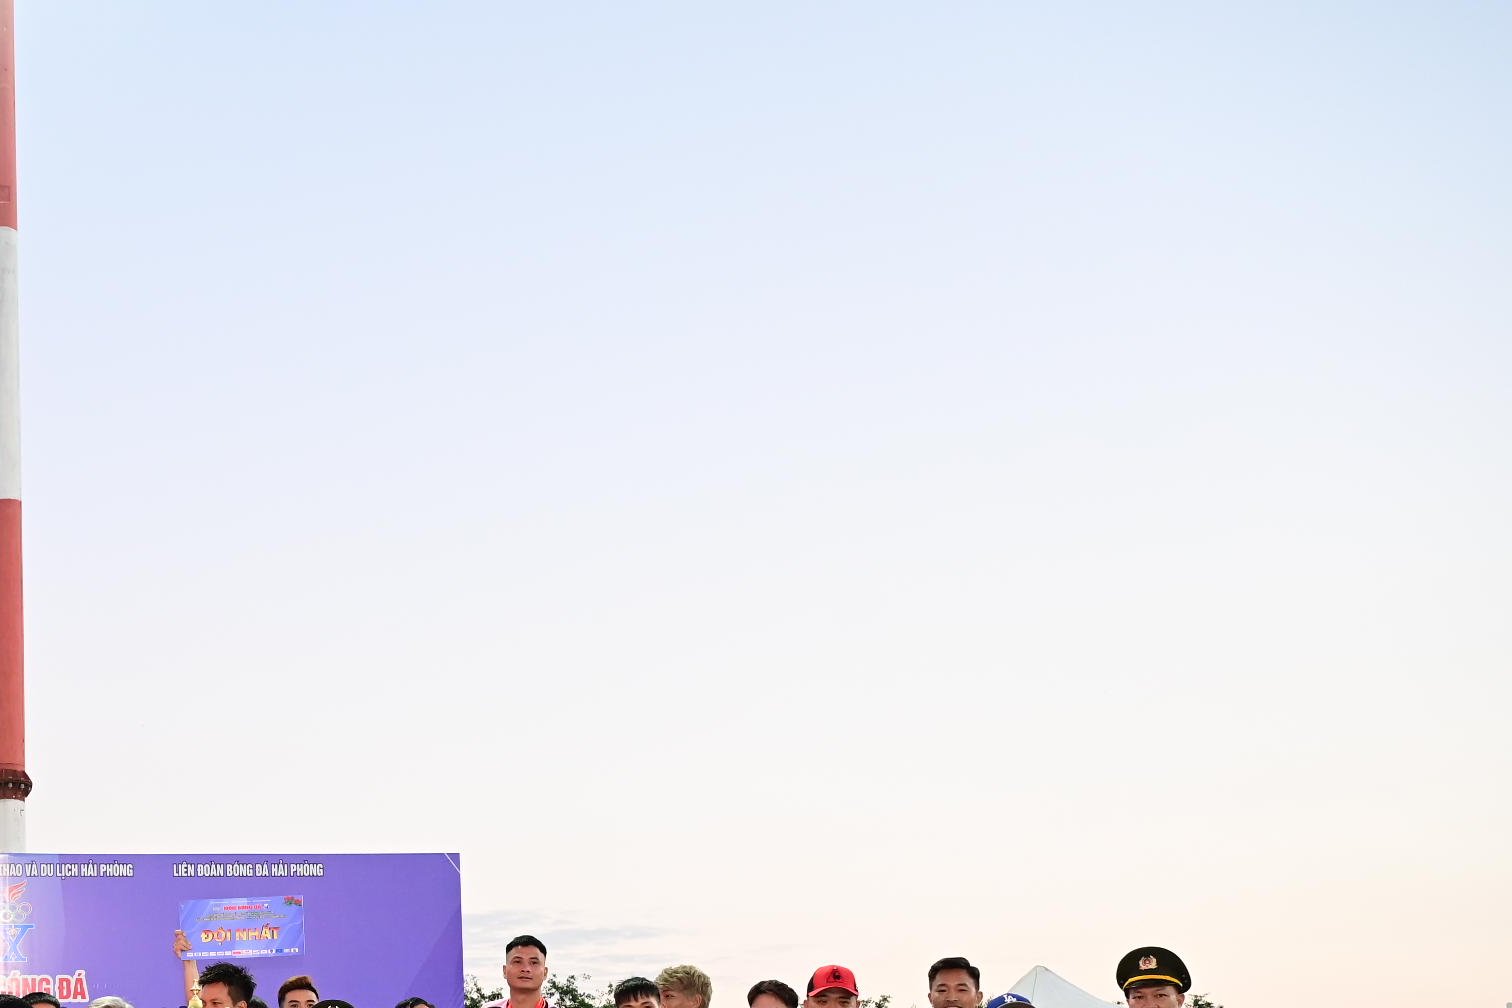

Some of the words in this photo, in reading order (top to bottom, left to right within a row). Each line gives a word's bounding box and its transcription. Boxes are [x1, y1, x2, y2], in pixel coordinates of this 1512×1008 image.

[25, 860, 39, 877] VÀ
[40, 863, 54, 877] DU
[56, 863, 79, 880] LỊCH
[80, 859, 98, 877] HẢI
[99, 860, 134, 877] PHÒNG
[173, 860, 195, 877] LIÊN
[197, 860, 224, 877] ĐOÀN
[226, 860, 253, 877] BÓNG
[255, 860, 269, 877] ĐÁ
[271, 859, 288, 877] HẢI
[290, 860, 324, 877] PHÒNG
[200, 926, 232, 946] ĐỘI
[235, 922, 281, 941] NHẤT
[57, 971, 88, 1001] ĐÁ
